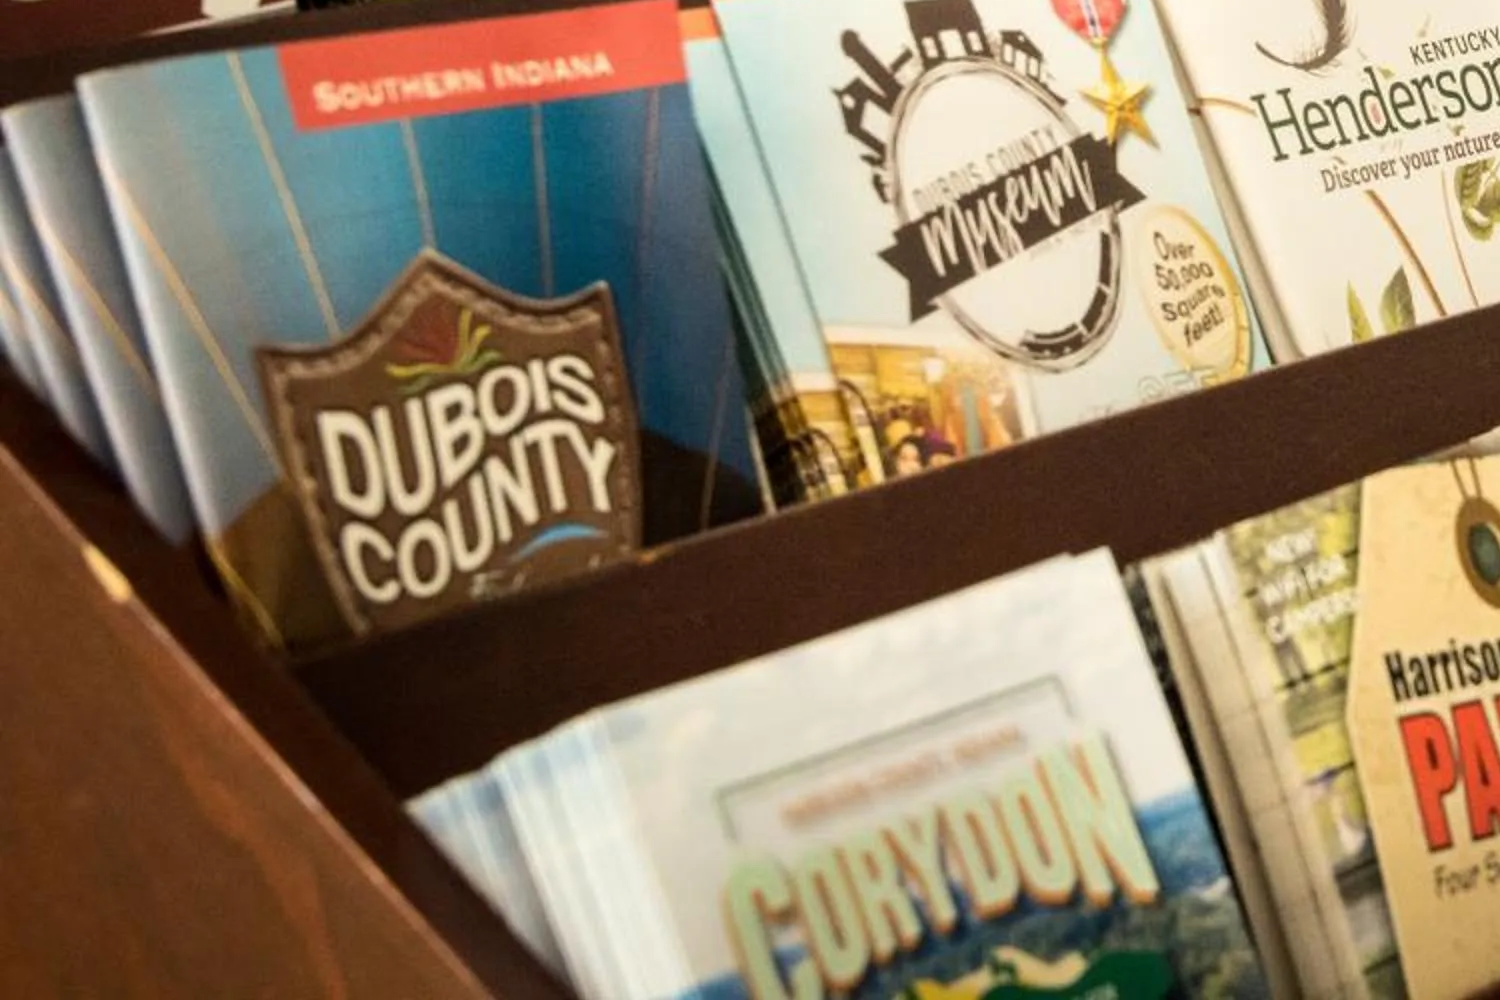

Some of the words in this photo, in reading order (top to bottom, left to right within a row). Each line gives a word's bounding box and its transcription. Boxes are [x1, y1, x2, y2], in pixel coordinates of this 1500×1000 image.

[311, 65, 486, 114] SOUTHERN
[491, 51, 616, 91] INDIANA
[1320, 153, 1399, 194] Discover
[1400, 146, 1442, 181] your
[1153, 231, 1196, 262] Over
[1153, 261, 1215, 292] 50,000
[316, 354, 606, 519] DUBOIS
[340, 418, 616, 602] COUNTY
[722, 728, 1160, 1000] CORYDON
[1433, 865, 1481, 900] Four
